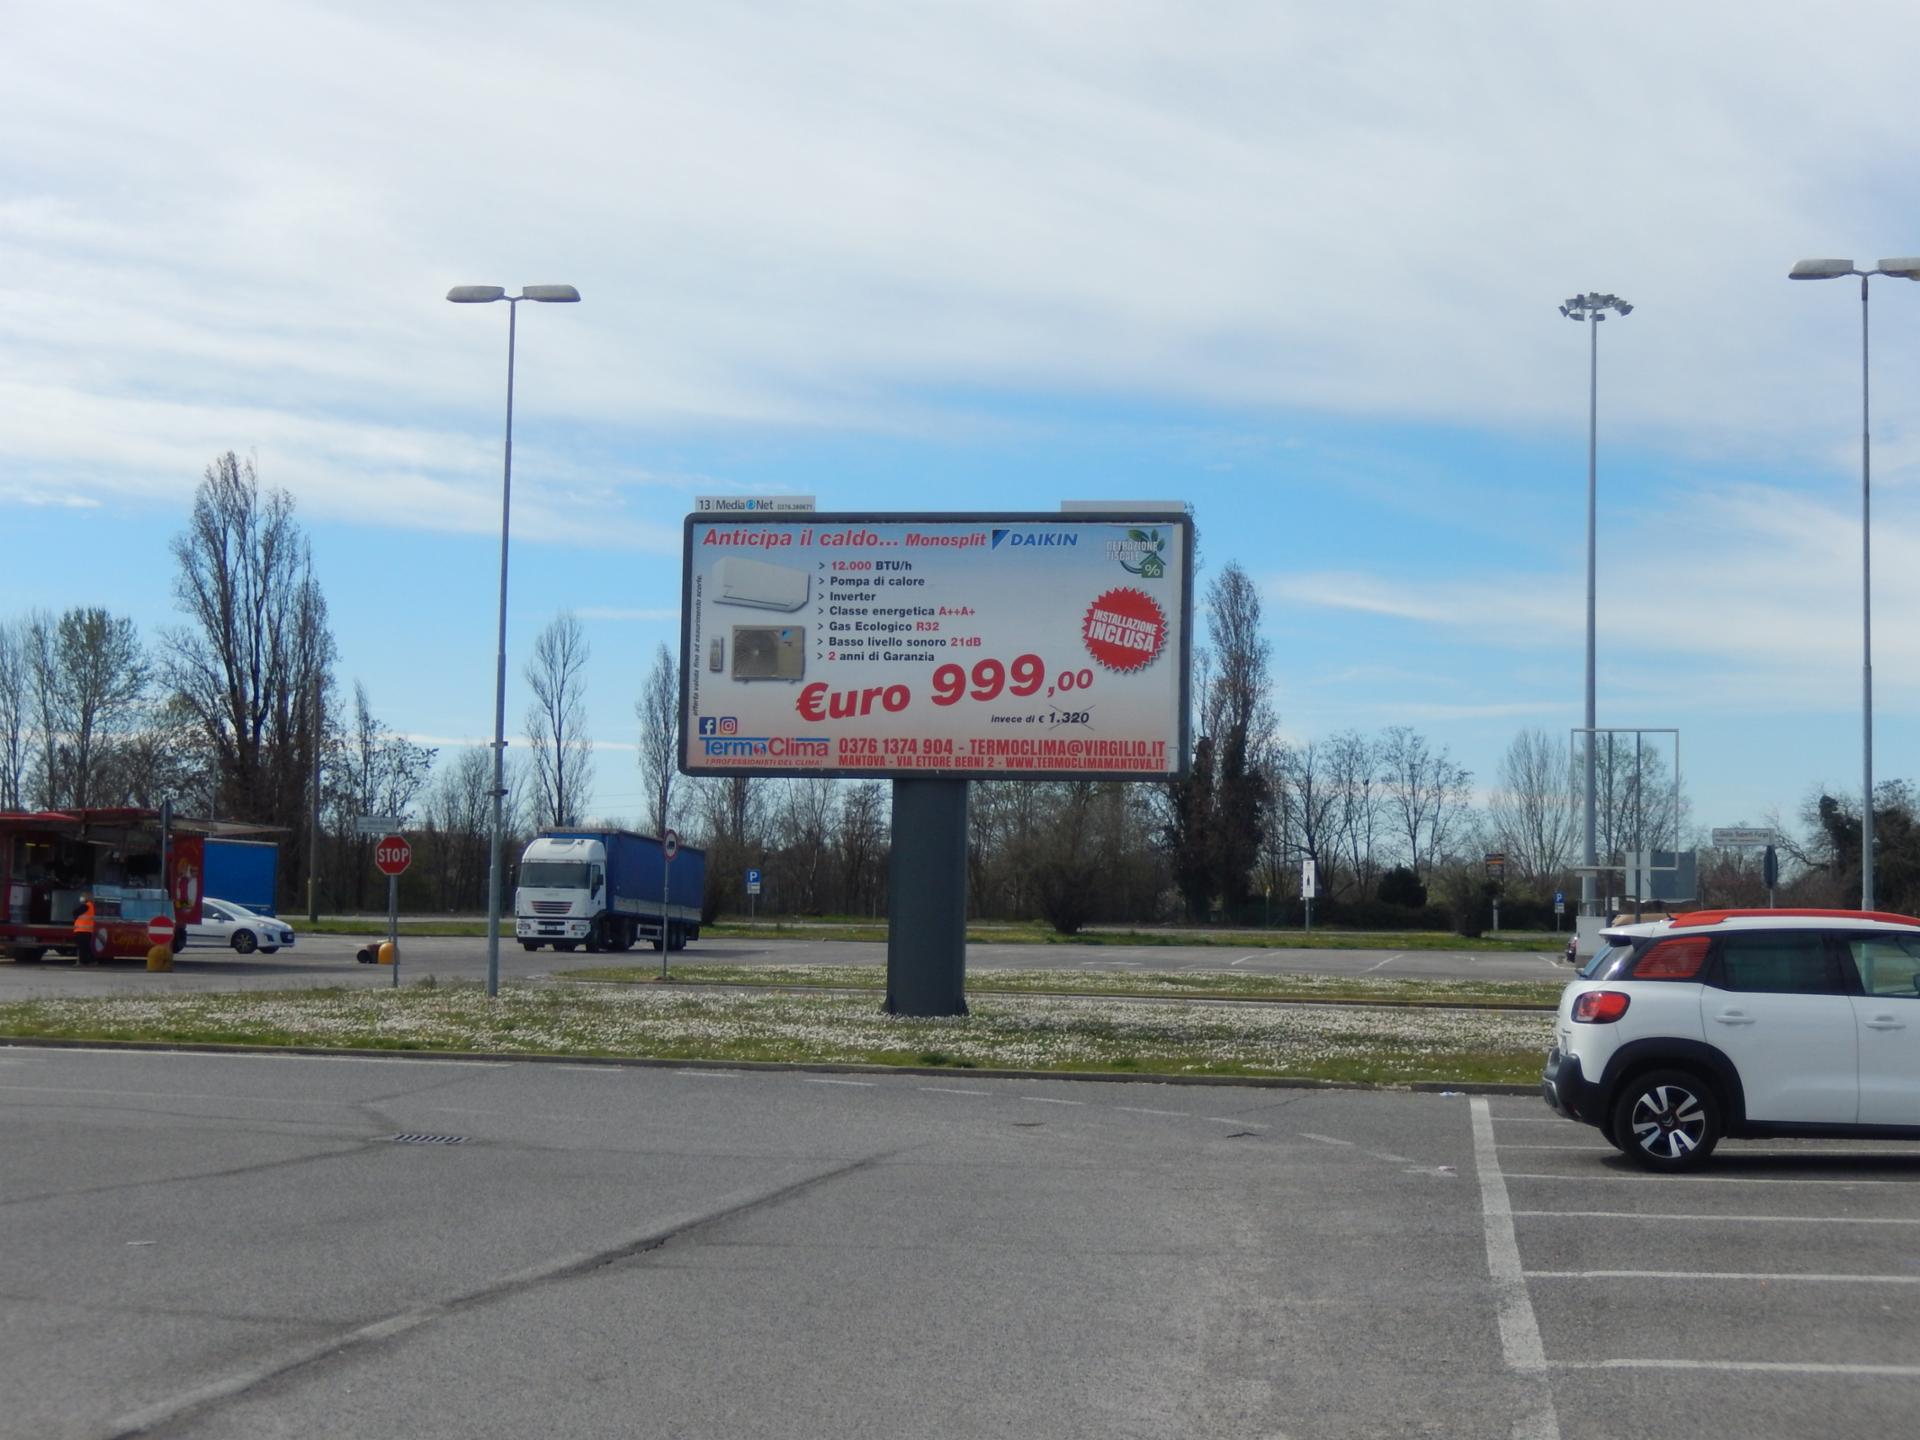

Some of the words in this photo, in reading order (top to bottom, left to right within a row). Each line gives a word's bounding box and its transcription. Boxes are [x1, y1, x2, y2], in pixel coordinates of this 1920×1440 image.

[699, 500, 711, 510] 13
[703, 528, 792, 549] Anticipa
[800, 529, 813, 546] il
[820, 530, 898, 546] caldo...
[906, 532, 987, 548] Monosplit
[1010, 533, 1078, 546] DAIKIN
[831, 561, 872, 570] 12.000
[875, 560, 912, 571] BTU/h
[830, 577, 870, 588] Pompa
[874, 576, 885, 586] di
[889, 577, 925, 586] calore
[830, 592, 876, 601] Inverter
[830, 606, 868, 616] Classe
[872, 606, 935, 618] energetica
[829, 622, 850, 632] Gas
[855, 622, 912, 633] Ecologico
[916, 622, 939, 632] R32
[1092, 608, 1158, 635] INSTALLAZIONE
[1088, 620, 1155, 652] INCLUSA
[829, 637, 864, 647] Basso
[868, 637, 902, 647] livello
[906, 639, 946, 648] sonoro
[951, 637, 982, 647] 21dB
[828, 651, 836, 661] 2
[840, 652, 864, 661] anni
[868, 651, 879, 662] di
[883, 651, 935, 662] Garanzia
[795, 682, 911, 722] €uro
[990, 714, 1022, 723] invece
[1025, 714, 1036, 723] di
[1049, 712, 1090, 724] 1.320
[699, 737, 830, 757] TermoClima
[839, 738, 878, 754] 0376
[883, 738, 917, 755] 1374
[923, 739, 953, 755] 904
[970, 739, 1166, 757] TERMOCLIMA@VIRGILIO.IT
[838, 756, 885, 766] MANTOVA
[896, 756, 912, 767] VIA
[916, 756, 951, 767] ETTORE
[955, 756, 984, 768] BERNI
[988, 757, 994, 767] 2
[1006, 757, 1165, 770] WWW.TERMOCLIMAMANTOVA.IT
[378, 848, 409, 862] STOP
